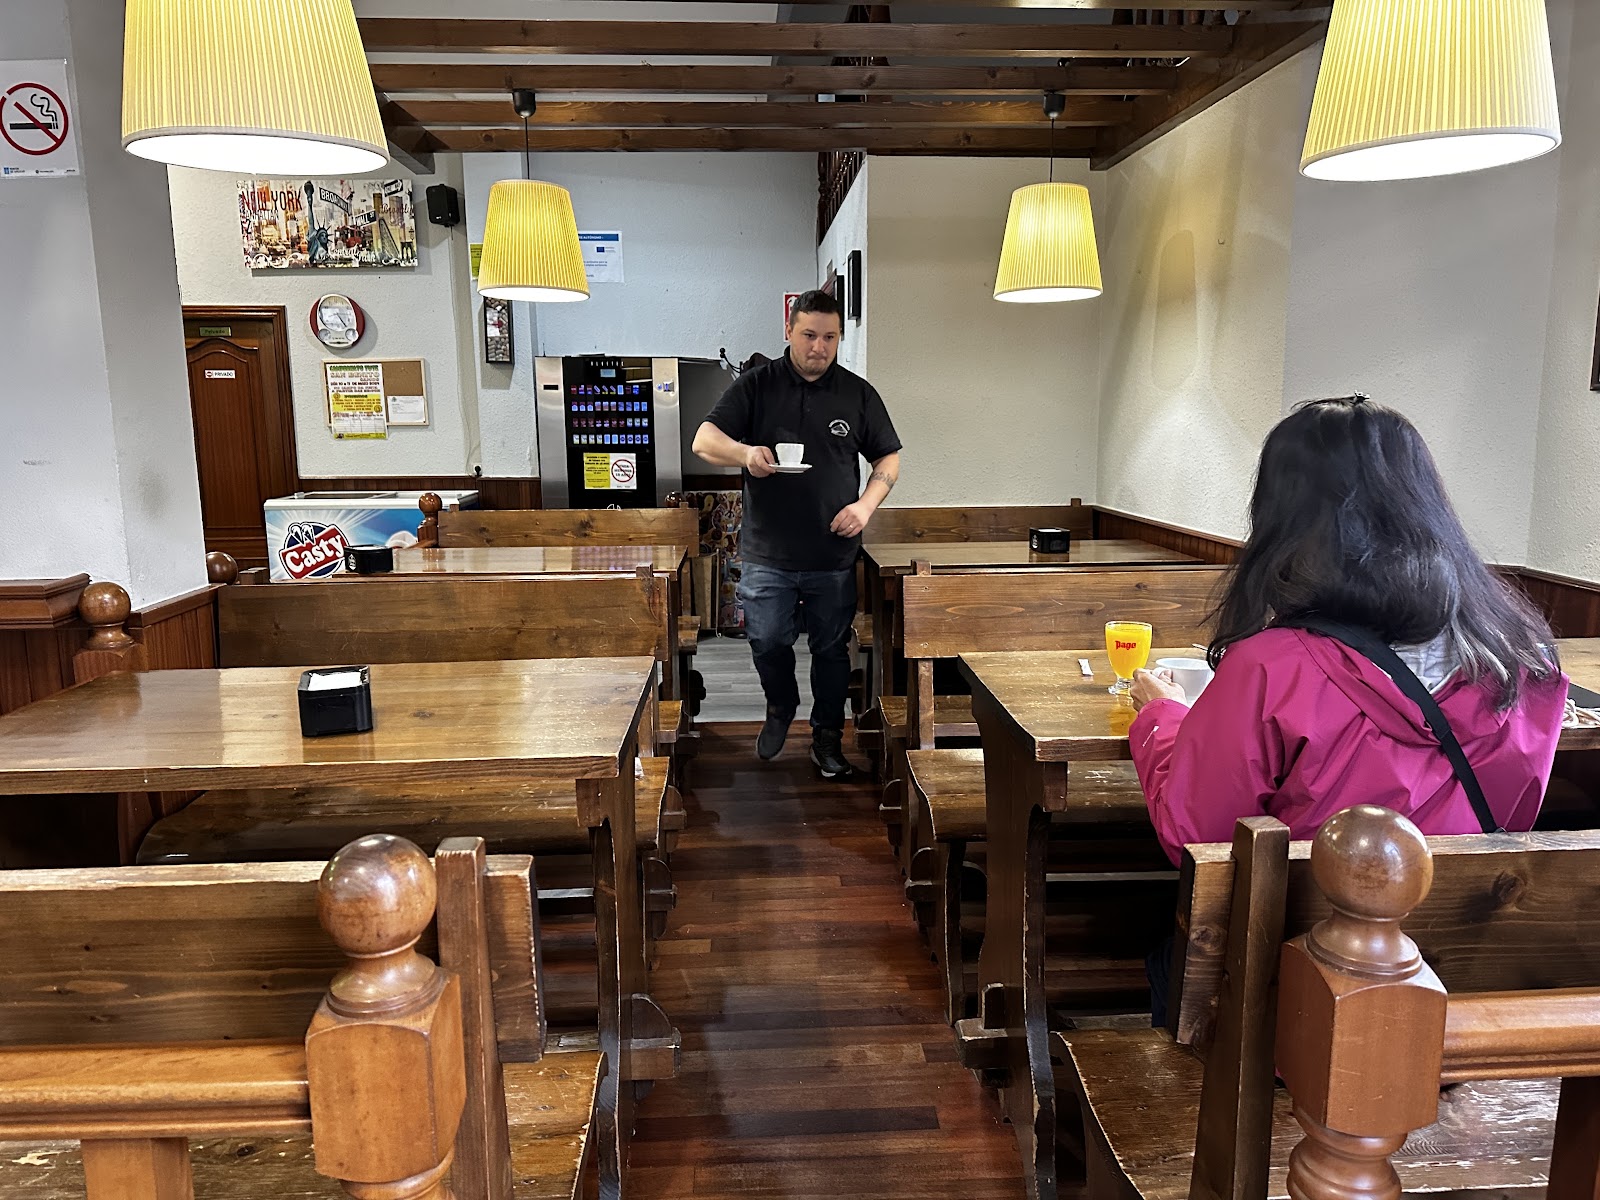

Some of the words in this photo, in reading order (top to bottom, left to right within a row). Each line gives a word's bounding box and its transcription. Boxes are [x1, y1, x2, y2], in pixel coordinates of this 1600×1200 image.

[242, 190, 267, 211] NEW
[270, 190, 303, 211] YORK
[320, 188, 348, 211] BROADWAY
[285, 534, 345, 573] Casty
